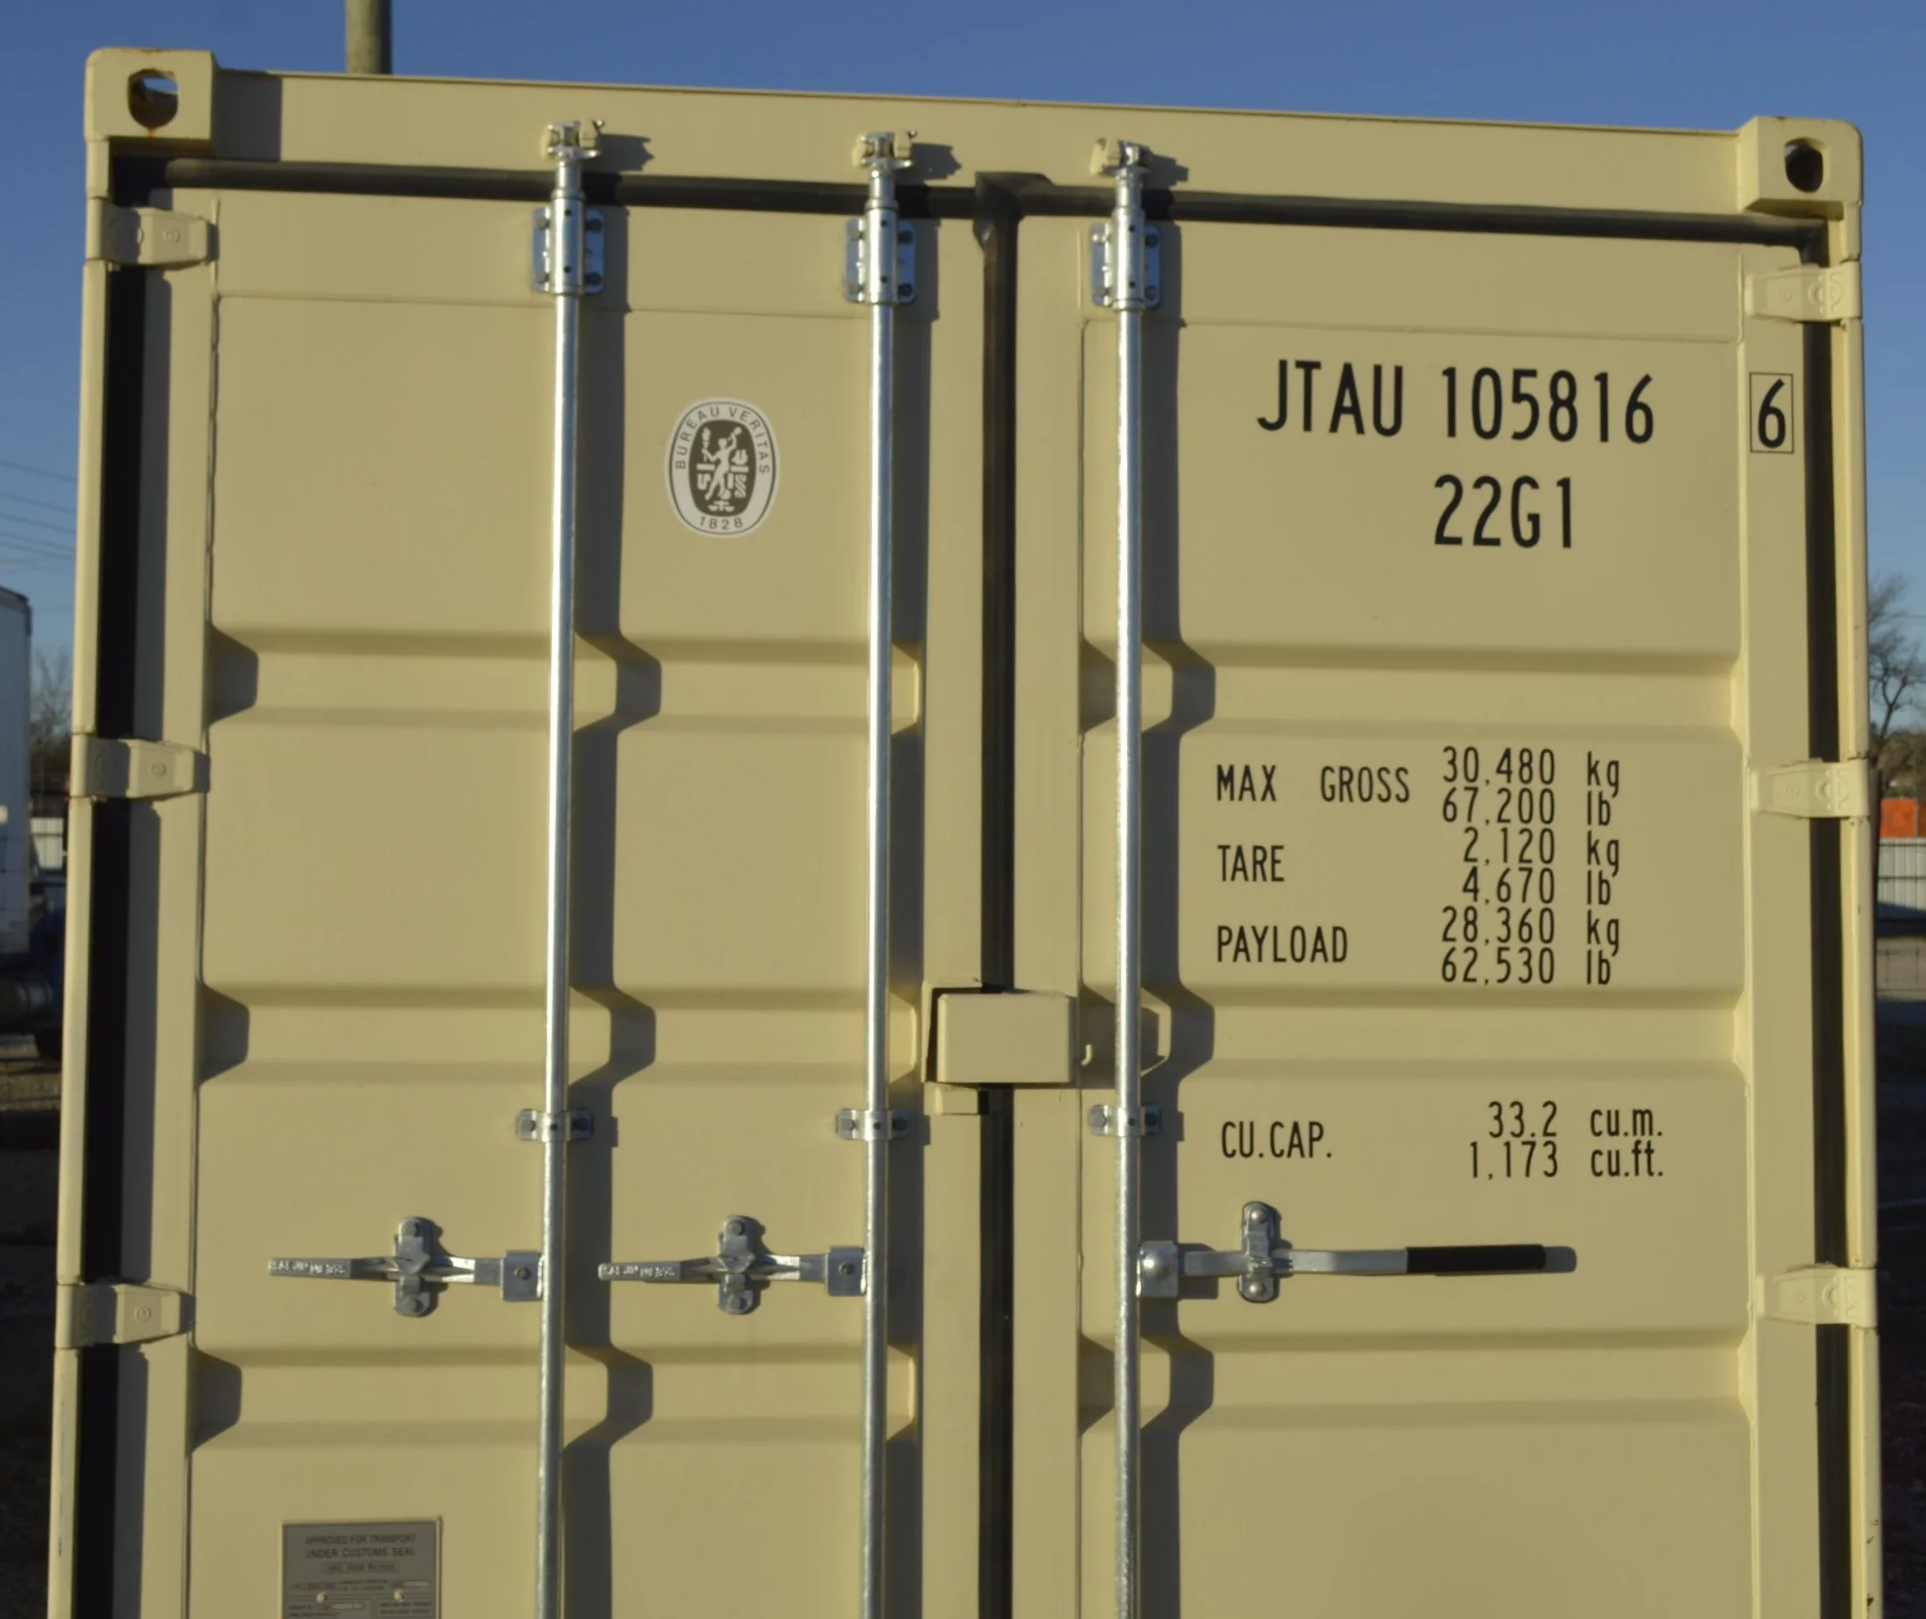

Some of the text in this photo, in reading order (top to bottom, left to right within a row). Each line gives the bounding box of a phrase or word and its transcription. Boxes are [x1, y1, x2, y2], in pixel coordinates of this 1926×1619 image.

[1256, 358, 1787, 449] JTAU 105816 6
[674, 406, 770, 474] BUREAU VERITAS
[699, 516, 743, 530] 1828
[1433, 473, 1572, 549] 22G1
[1216, 763, 1410, 804] MAX GROSS
[1442, 745, 1620, 799] 30,480 kg
[1442, 785, 1612, 827] 67,200 lb
[1216, 844, 1285, 883] TARE
[1462, 825, 1620, 879] 2,120 kg
[1461, 865, 1612, 906] 4,670 lb
[1217, 924, 1348, 964] PAYLOAD
[1441, 905, 1620, 958] 28,360 kg
[1441, 945, 1612, 986] 62,530 lb
[1220, 1120, 1332, 1159] CU.CAP.
[1488, 1099, 1663, 1139] 33.2 cu.m.
[1469, 1138, 1664, 1181] 1,173 cu.ft.
[304, 1546, 416, 1559] UNDER CUSTOMS SEAL
